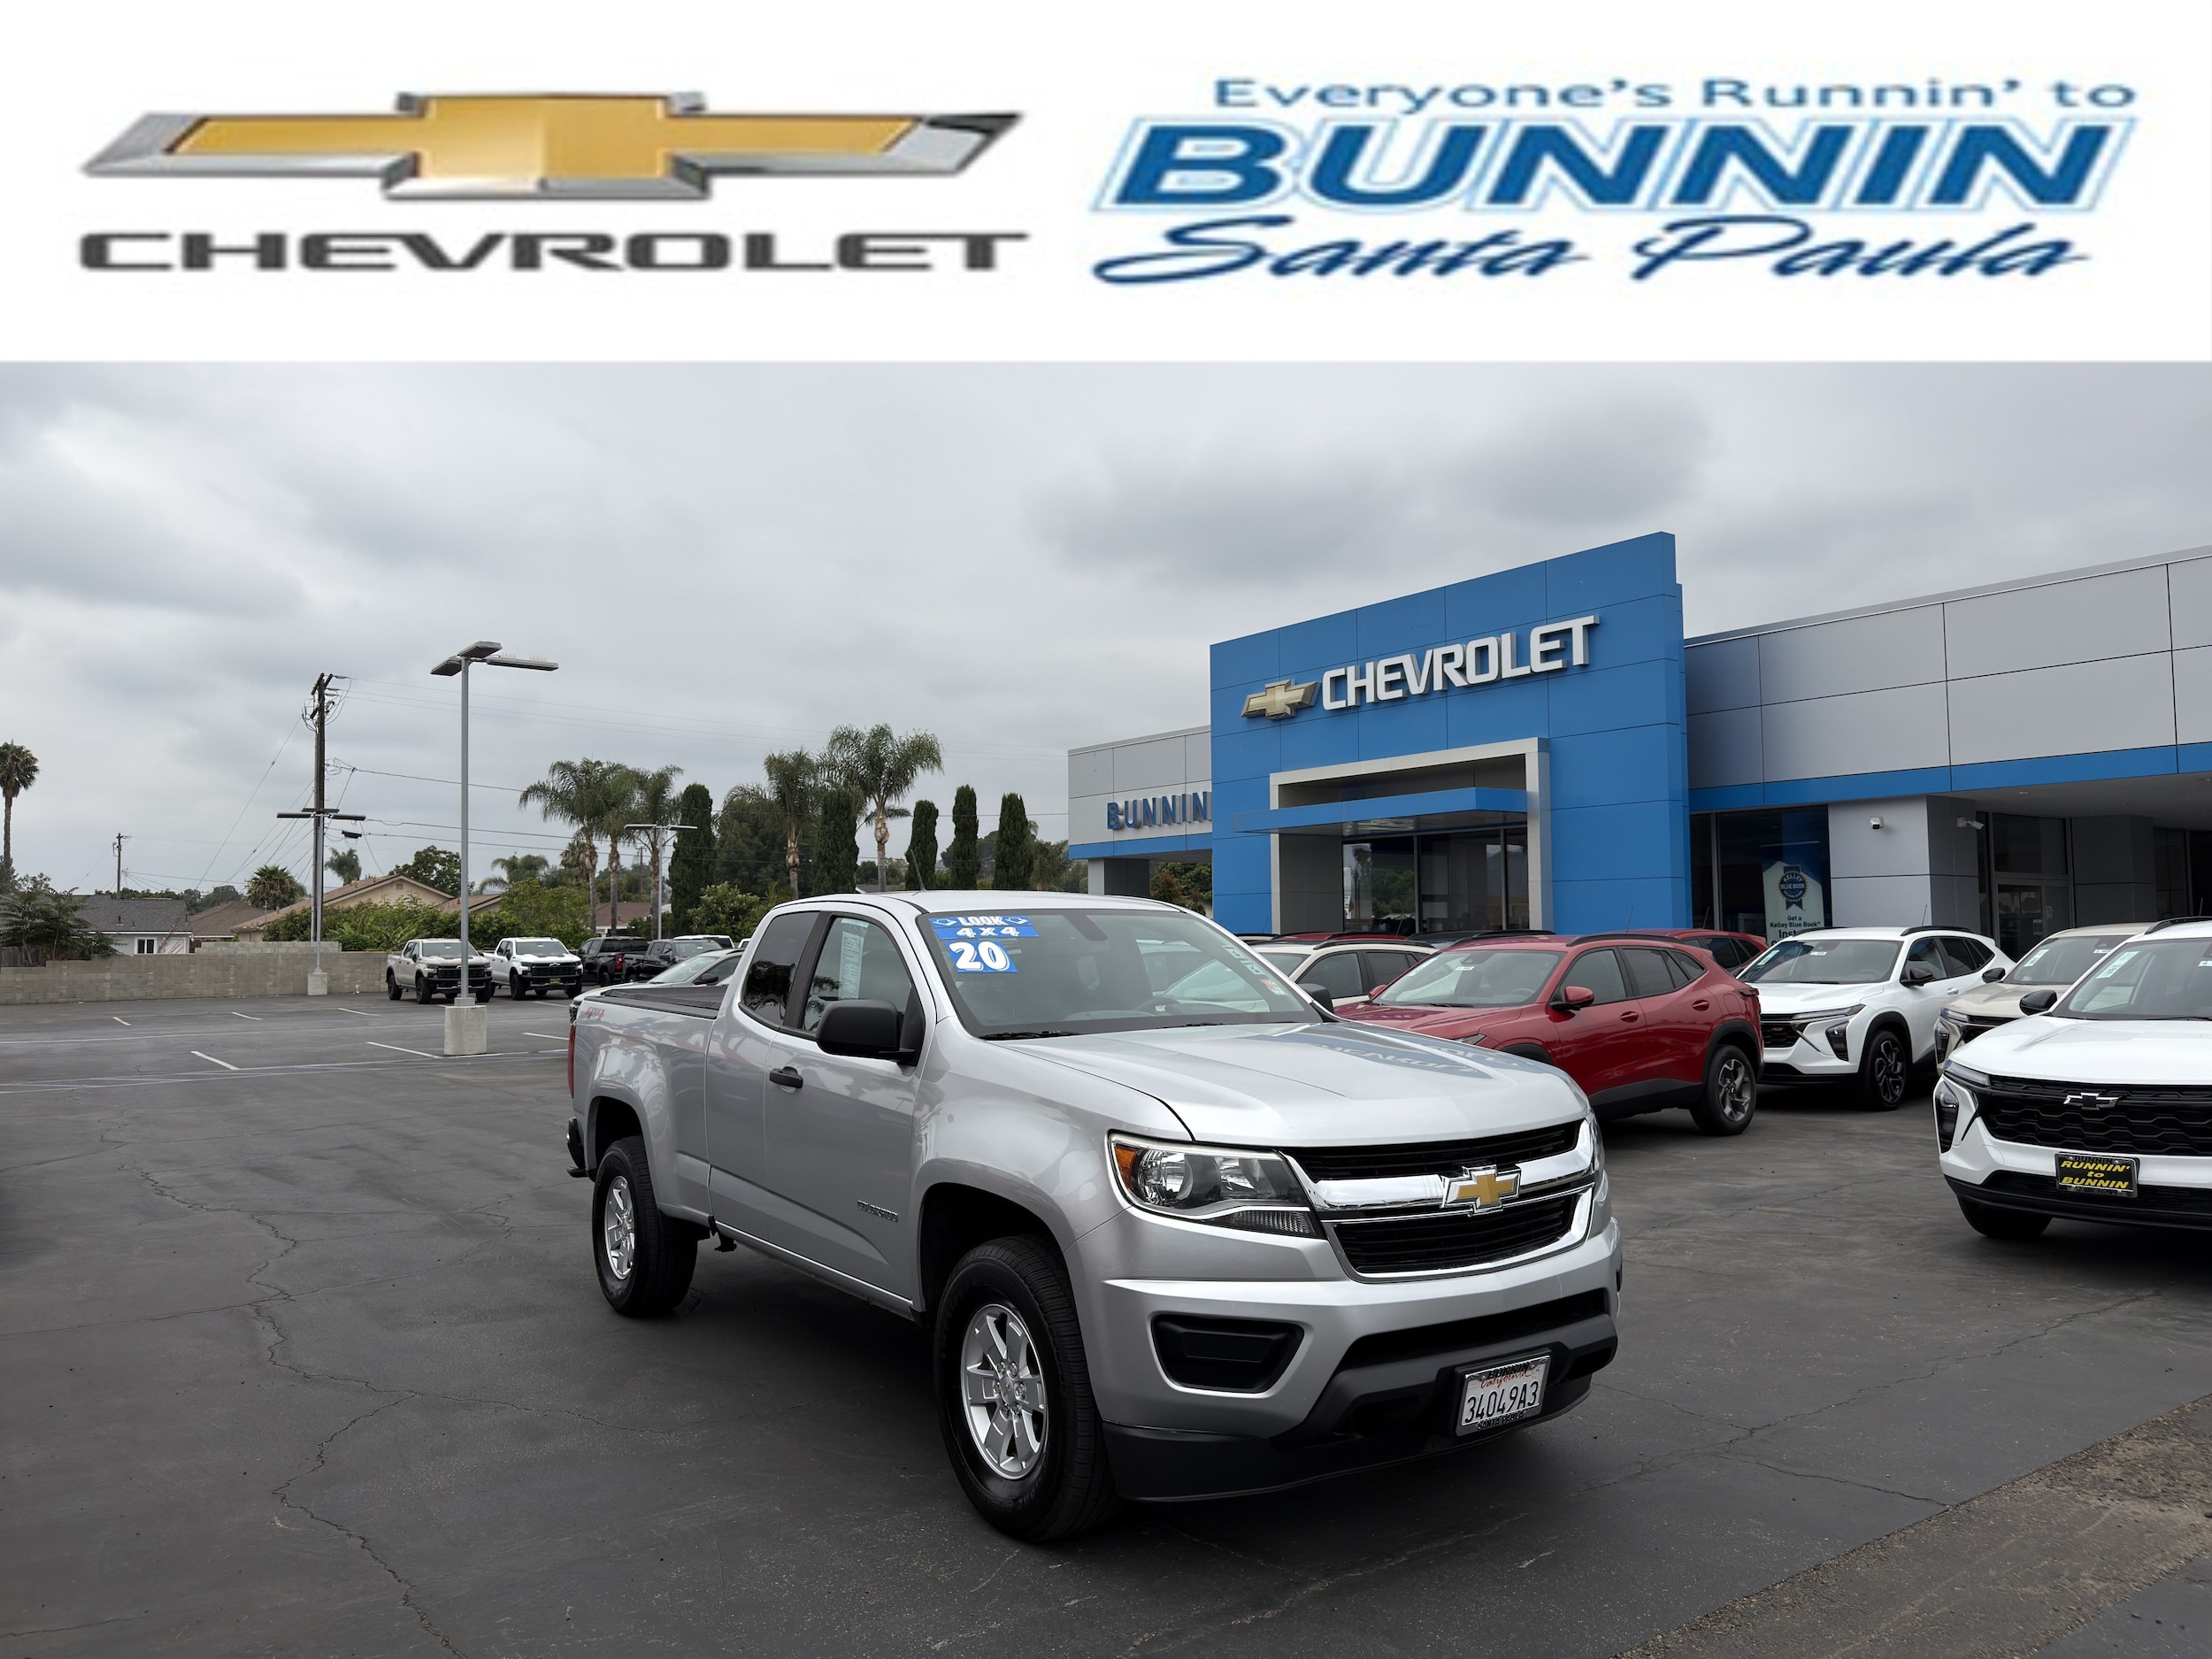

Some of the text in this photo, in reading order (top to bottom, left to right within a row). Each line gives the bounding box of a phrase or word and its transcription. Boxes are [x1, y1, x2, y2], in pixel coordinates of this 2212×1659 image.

[1322, 614, 1600, 711] CHEVROLET
[1107, 790, 1212, 831] BUNNIN
[956, 916, 1008, 926] LOOK
[949, 941, 1010, 972] 20
[2061, 1160, 2131, 1172] RUNNIN'
[2062, 1176, 2129, 1188] BUNNIN
[1464, 1380, 1539, 1423] 34049A3
